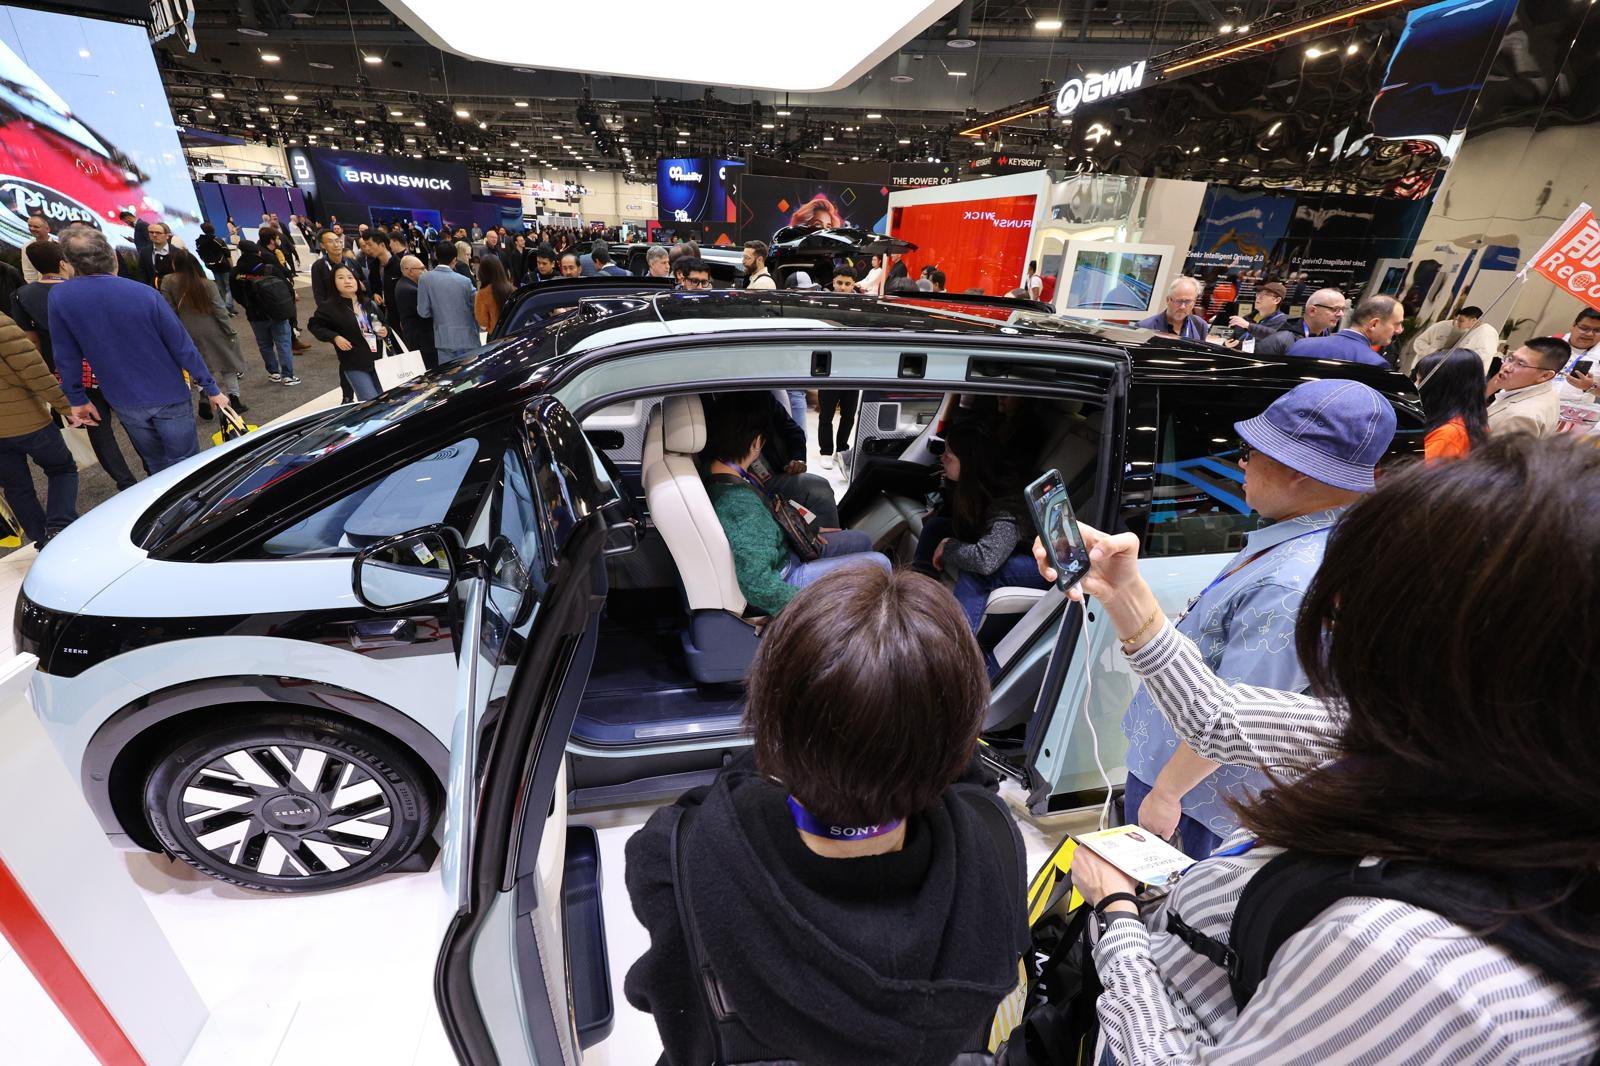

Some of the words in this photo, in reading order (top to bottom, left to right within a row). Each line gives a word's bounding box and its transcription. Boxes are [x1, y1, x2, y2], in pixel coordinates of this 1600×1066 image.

[1082, 61, 1146, 103] GWM
[1008, 158, 1042, 167] KEYSIGHT
[345, 170, 452, 191] BRUNSWICK
[892, 177, 908, 185] THE
[909, 177, 938, 185] POWER
[940, 177, 953, 185] OF
[1203, 252, 1233, 260] Intelligent
[1233, 253, 1253, 262] Driving
[63, 647, 88, 655] ZEEKR
[320, 736, 402, 783] MICHELIN
[274, 808, 311, 816] ZEEKR
[830, 825, 880, 837] SONY
